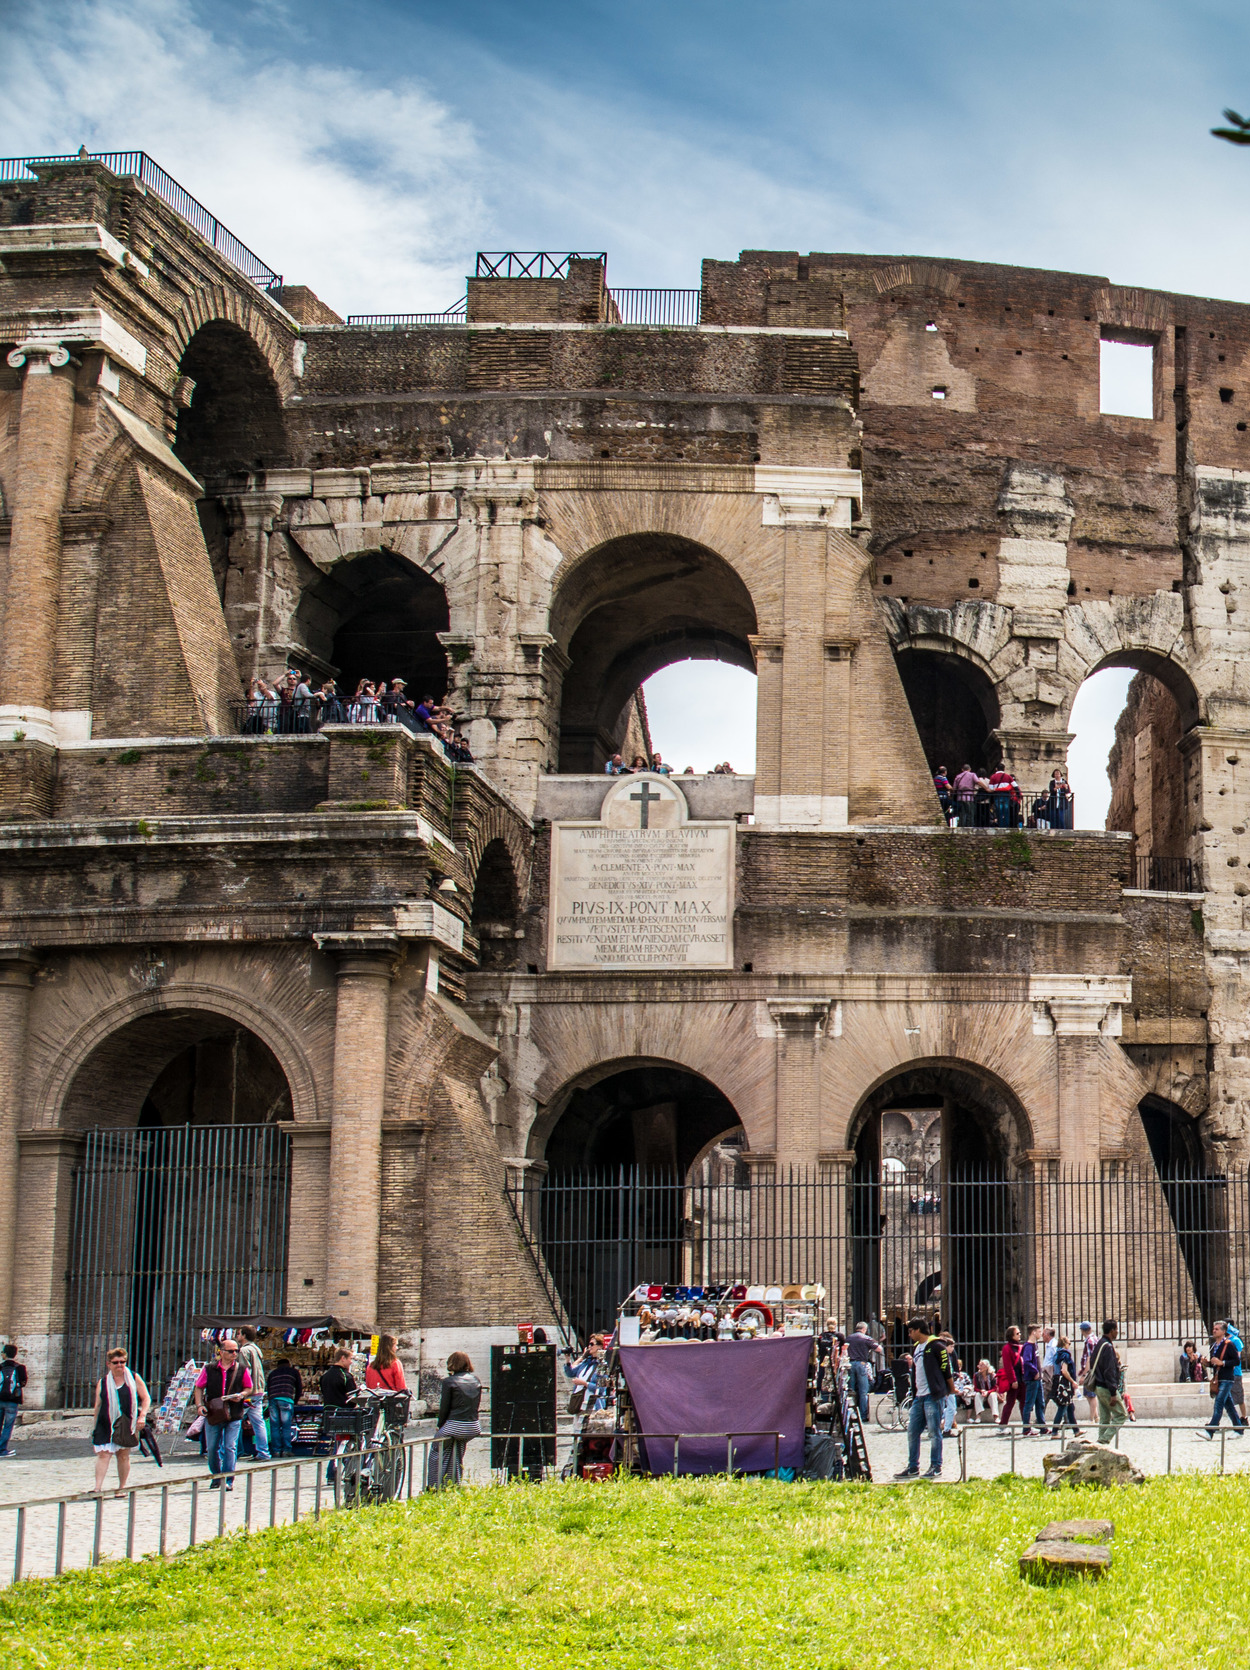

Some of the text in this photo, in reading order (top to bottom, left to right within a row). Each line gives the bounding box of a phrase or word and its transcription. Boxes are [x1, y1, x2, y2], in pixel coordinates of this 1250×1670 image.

[665, 830, 709, 838] FLAVIVM
[572, 900, 712, 914] PIVS IX PONT MAX
[620, 935, 630, 943] ET
